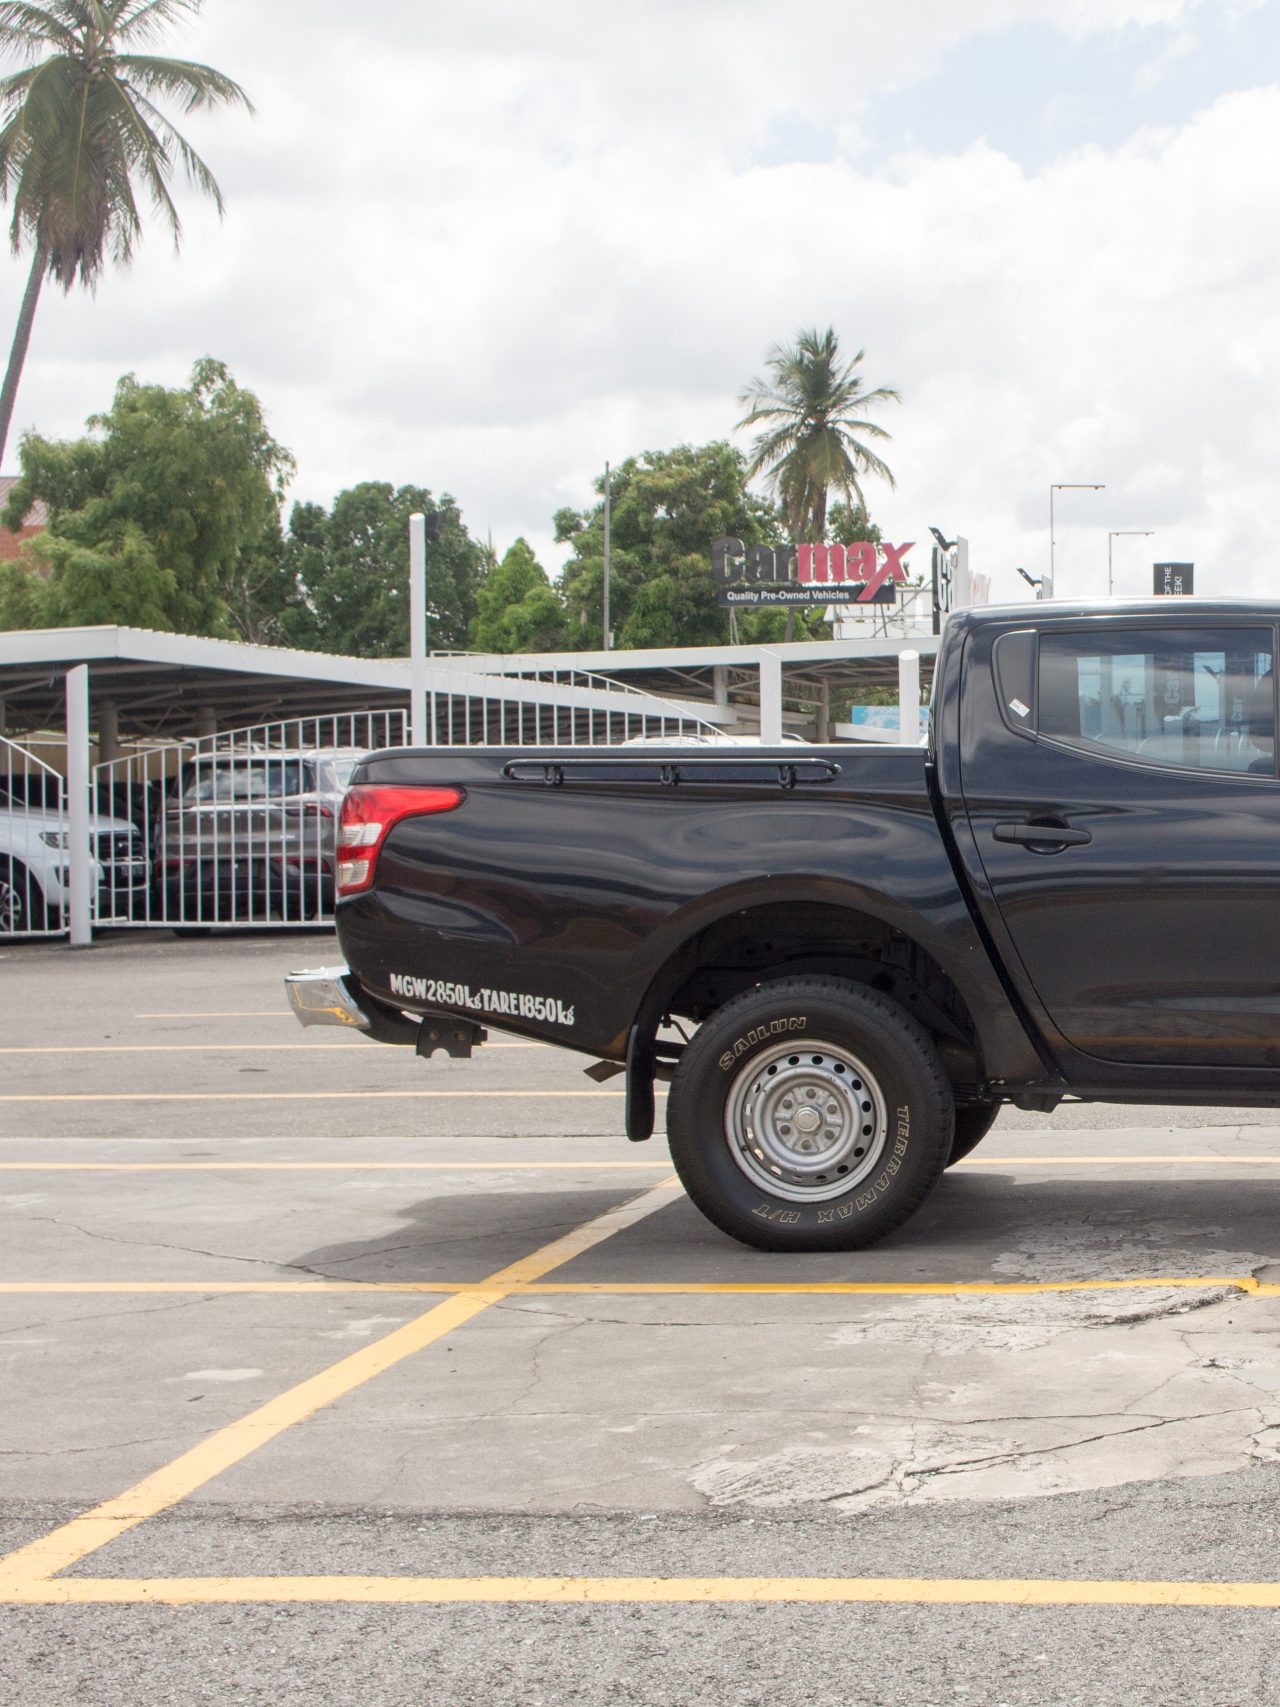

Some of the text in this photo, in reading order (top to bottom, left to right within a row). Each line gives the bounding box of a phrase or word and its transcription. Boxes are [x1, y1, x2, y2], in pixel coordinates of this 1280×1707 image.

[713, 535, 916, 602] Carmax
[1164, 566, 1172, 583] THE
[1174, 576, 1183, 595] EEK!
[727, 590, 850, 602] Quality Pre-Owned Vehicles
[719, 1016, 807, 1071] SAILUN
[752, 1104, 909, 1224] TERRAMAX H/T
